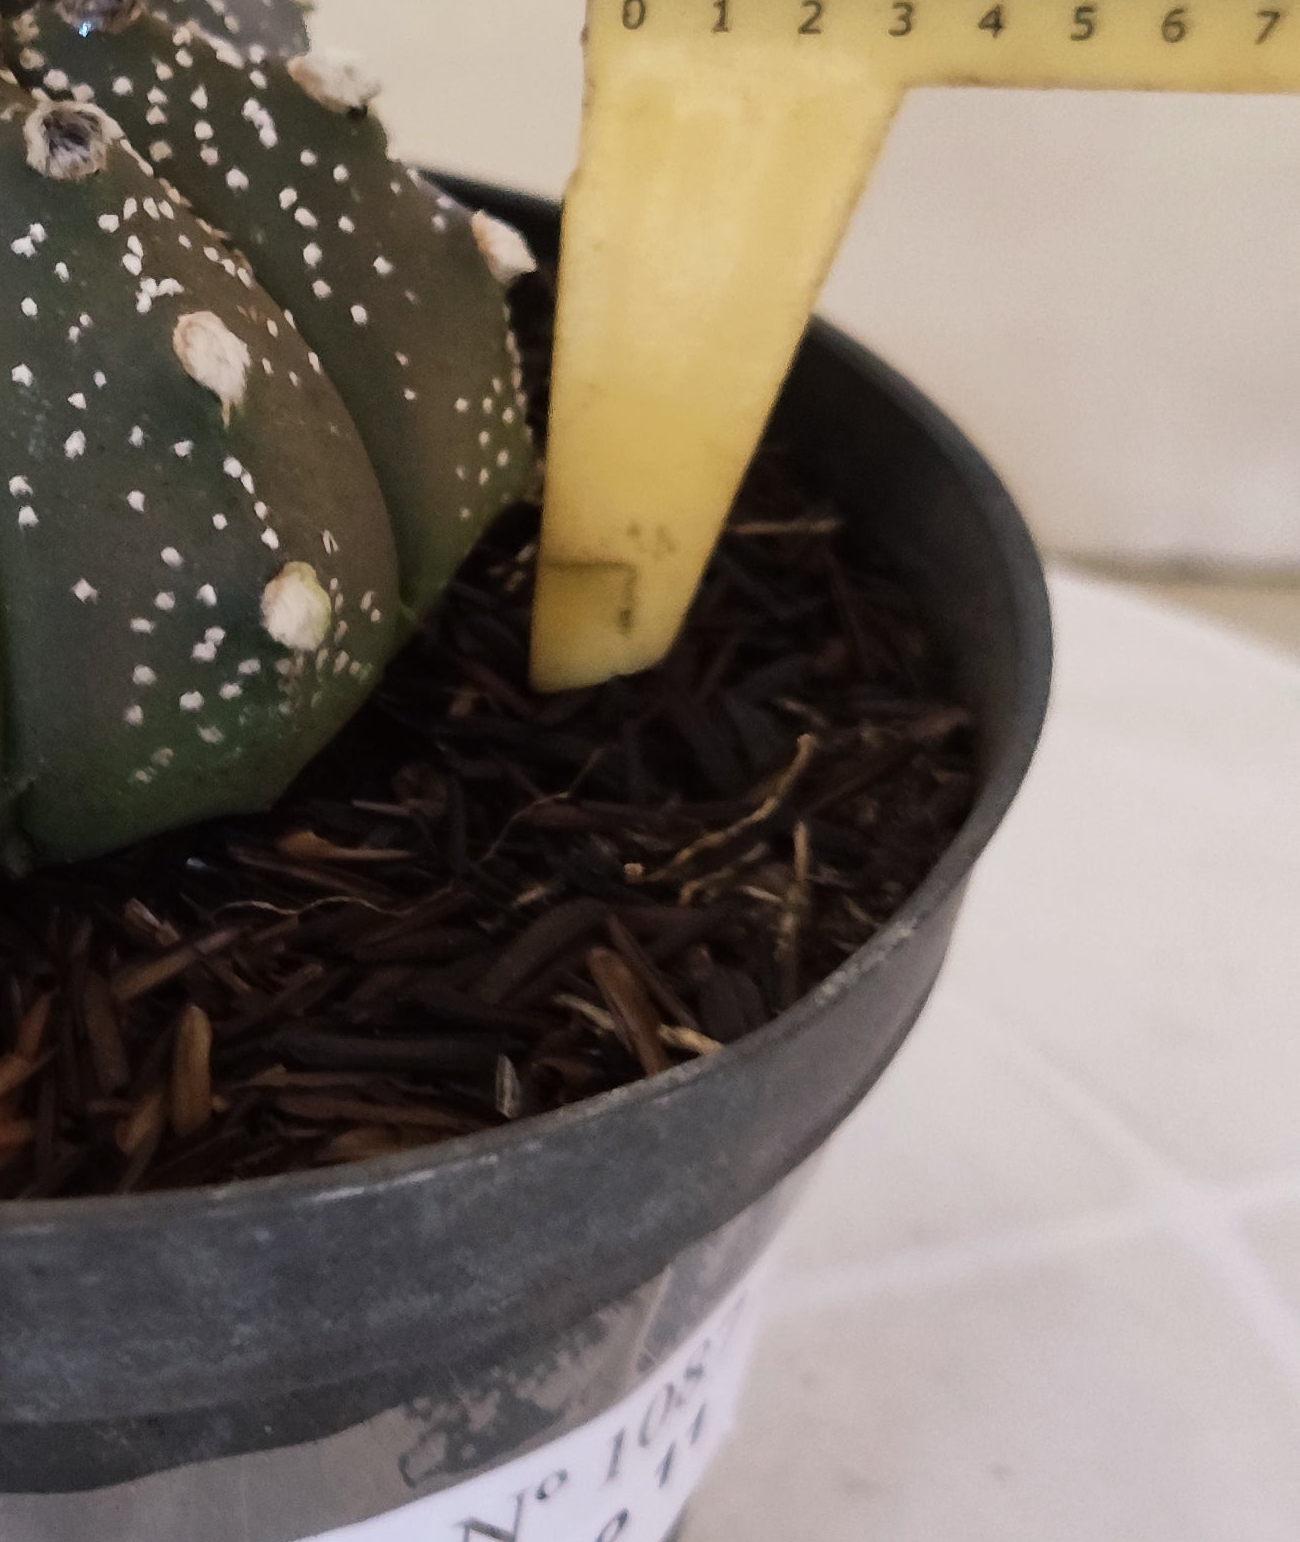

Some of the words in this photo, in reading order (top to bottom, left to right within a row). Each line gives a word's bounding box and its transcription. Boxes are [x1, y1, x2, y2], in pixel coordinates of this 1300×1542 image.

[711, 0, 731, 33] 1
[798, 0, 822, 35] 2
[888, 1, 914, 36] 3
[978, 4, 1004, 38] 4
[1070, 6, 1096, 42] 5
[1161, 8, 1187, 44] 6
[1254, 10, 1281, 45] 7
[655, 1402, 708, 1490] 11
